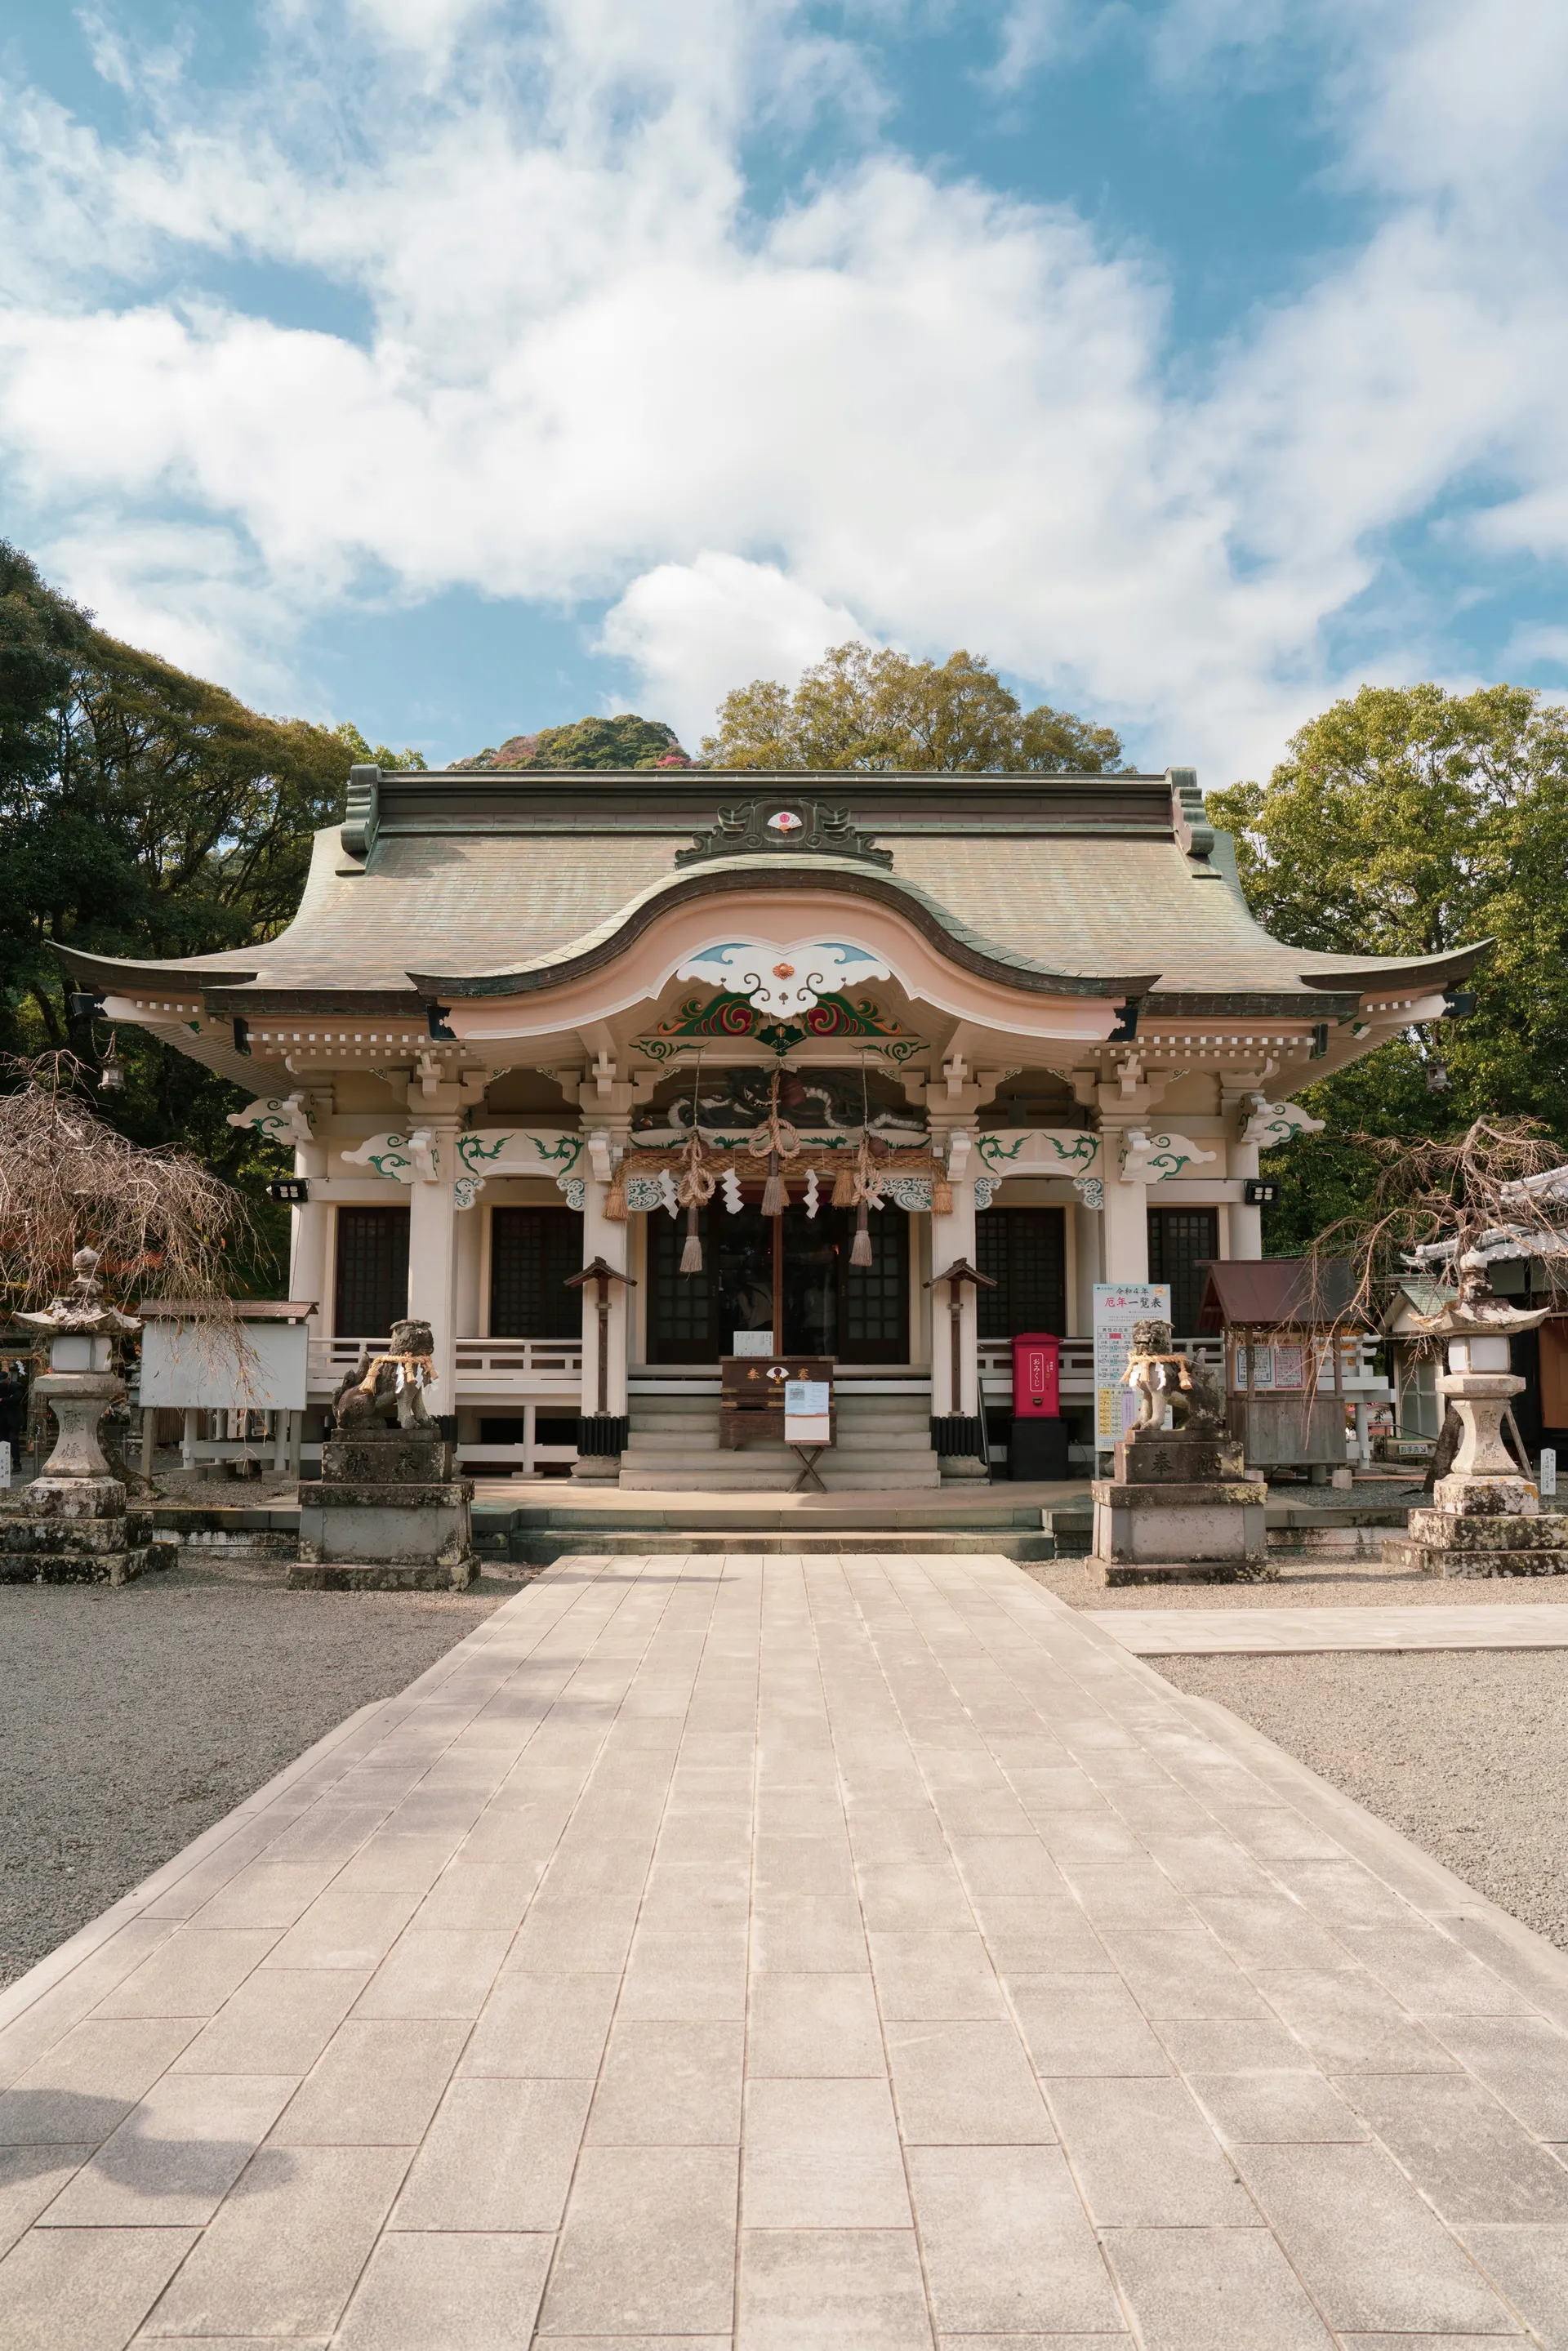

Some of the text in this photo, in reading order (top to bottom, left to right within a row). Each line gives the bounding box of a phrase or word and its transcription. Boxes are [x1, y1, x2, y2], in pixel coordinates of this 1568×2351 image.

[1116, 1287, 1149, 1295] 令和4年
[1104, 1297, 1162, 1308] 厄年一覧表
